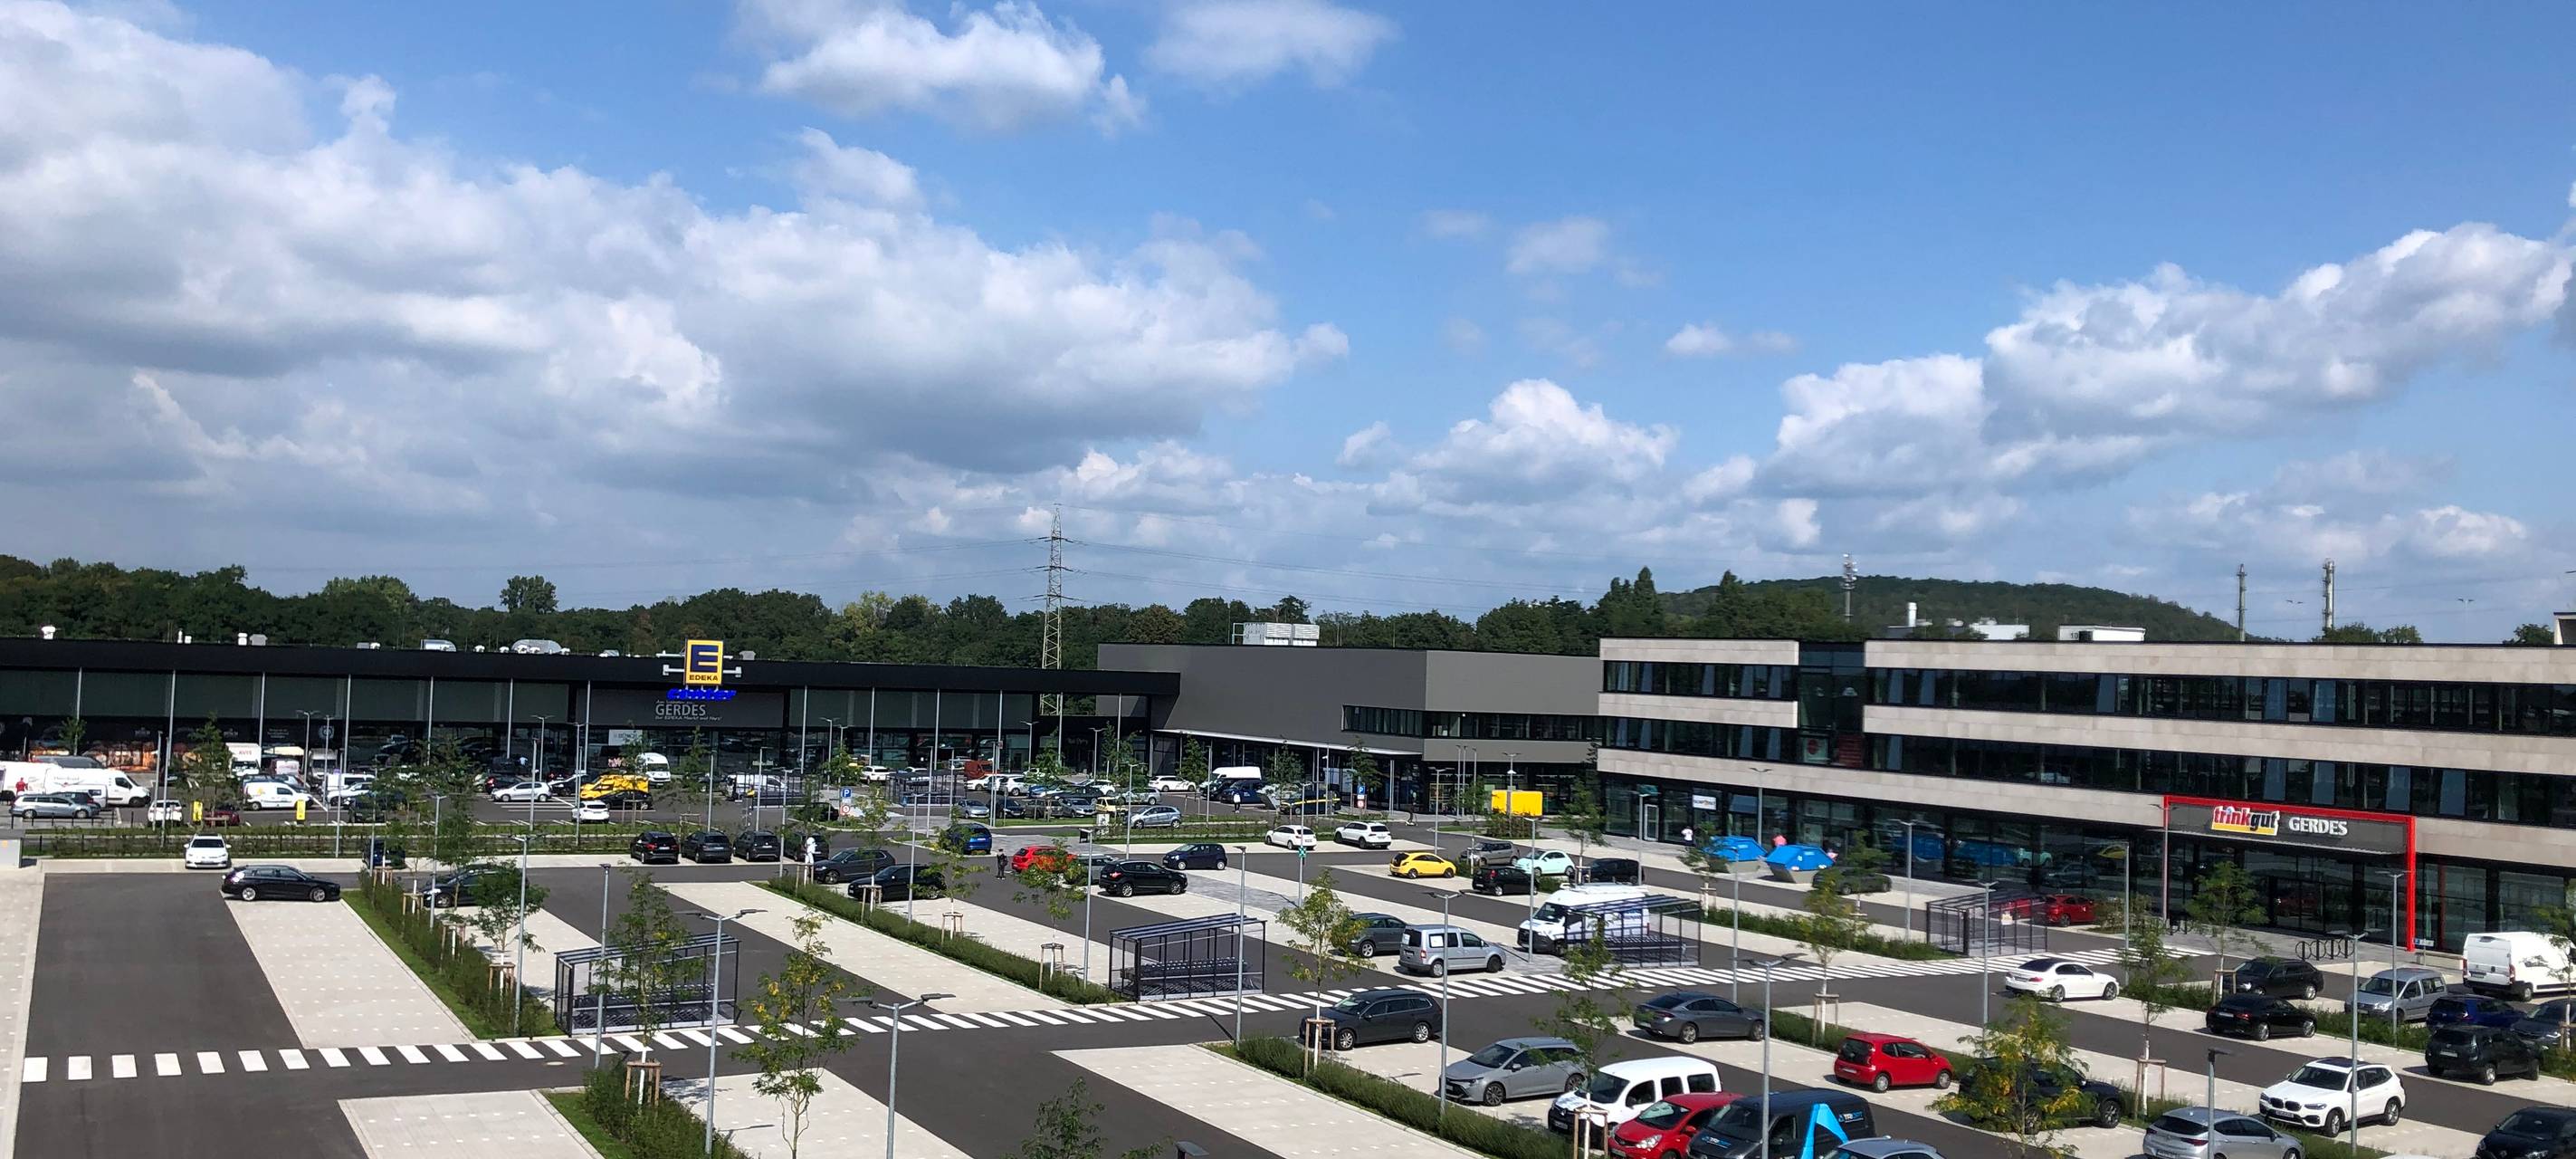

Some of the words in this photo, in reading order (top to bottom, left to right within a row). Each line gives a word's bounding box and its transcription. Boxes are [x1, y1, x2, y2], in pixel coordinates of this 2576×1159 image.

[655, 704, 706, 716] GERDES
[2213, 806, 2279, 832] trinkgut
[2289, 817, 2348, 836] GERDES
